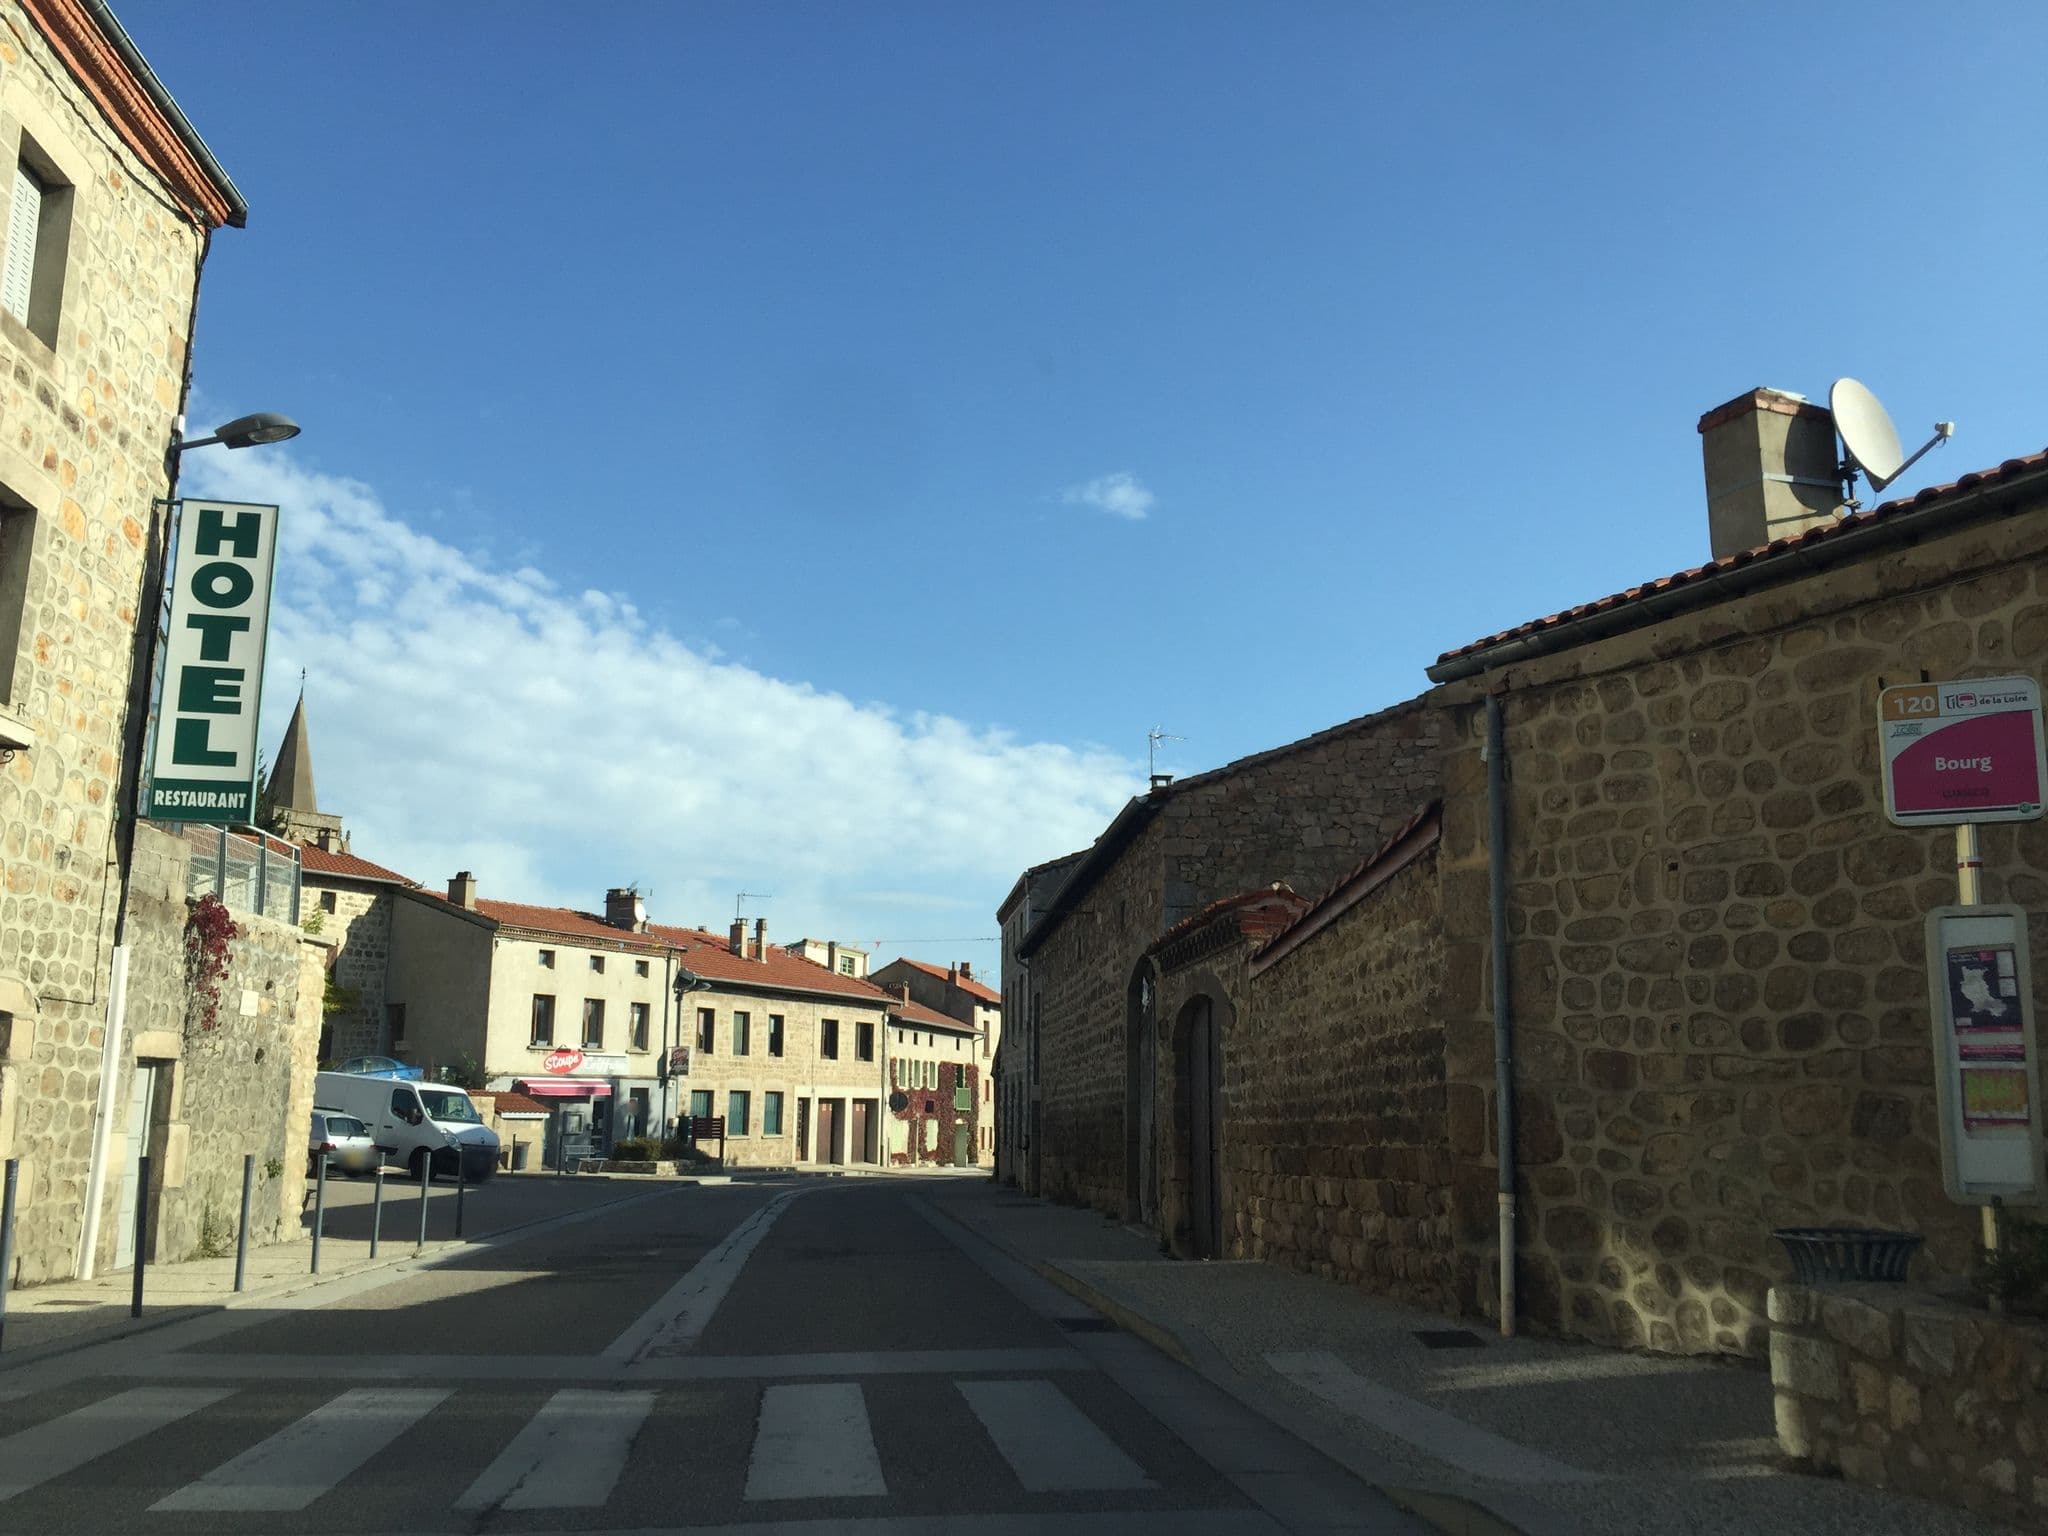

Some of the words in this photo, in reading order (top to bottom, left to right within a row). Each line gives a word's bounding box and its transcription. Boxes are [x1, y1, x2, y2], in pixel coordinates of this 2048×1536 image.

[172, 509, 261, 767] HOTEL
[1894, 696, 1936, 714] 120
[1993, 696, 2002, 704] la
[2004, 695, 2028, 704] Loire
[1935, 756, 1992, 772] Bourg
[154, 790, 247, 809] RESTAURANT
